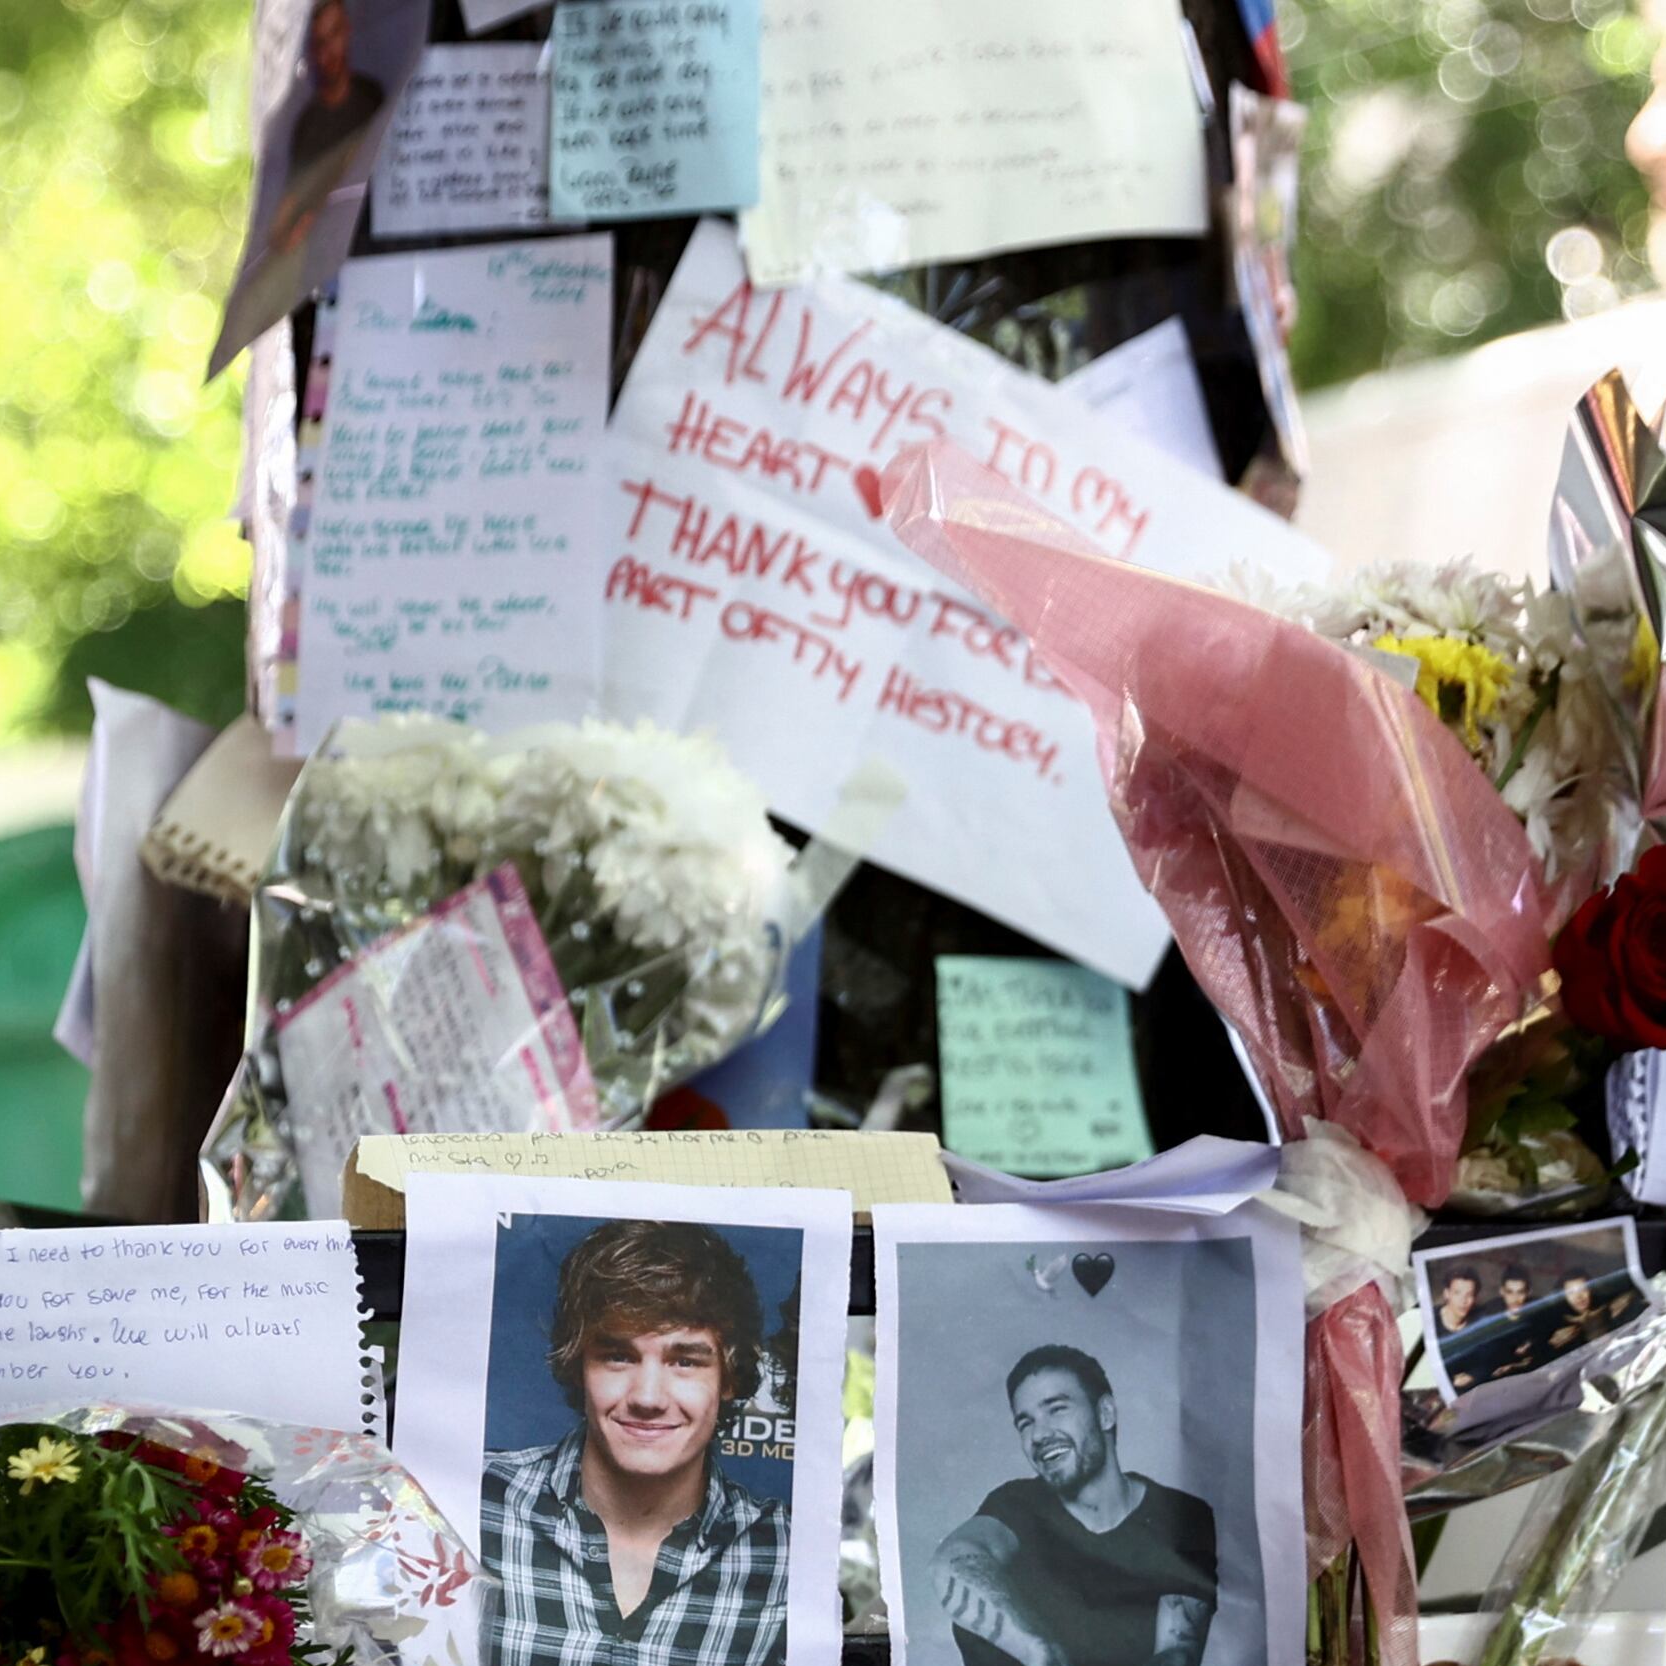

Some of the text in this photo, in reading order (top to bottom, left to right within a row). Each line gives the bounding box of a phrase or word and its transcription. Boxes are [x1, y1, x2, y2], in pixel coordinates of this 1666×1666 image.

[683, 274, 954, 456] ALWAYS
[665, 392, 854, 497] HEART
[605, 553, 722, 624] PART
[620, 478, 835, 598] THANK
[919, 593, 1027, 671] FOR
[6, 1247, 18, 1262] I
[29, 1239, 70, 1262] need
[80, 1241, 104, 1260] to
[111, 1239, 174, 1260] thank
[150, 1284, 187, 1306] me,
[241, 1280, 269, 1299] the
[280, 1278, 330, 1296] music
[163, 1319, 209, 1341] will
[225, 1316, 302, 1339] always
[721, 1440, 753, 1457] 3D
